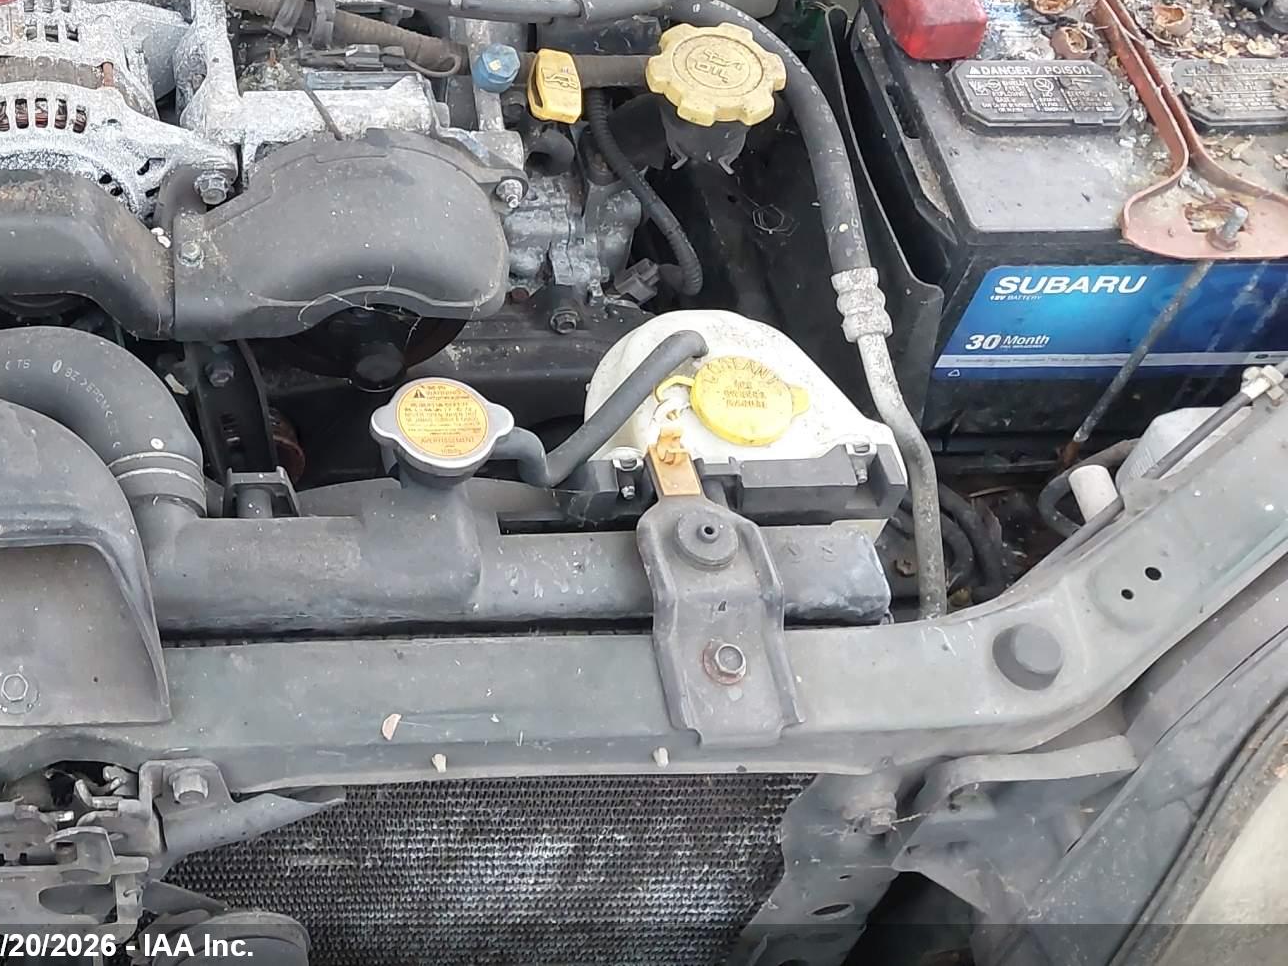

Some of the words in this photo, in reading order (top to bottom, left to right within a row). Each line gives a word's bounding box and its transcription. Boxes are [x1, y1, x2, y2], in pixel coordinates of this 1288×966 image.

[980, 65, 1033, 76] DANGER
[1043, 65, 1092, 76] POISON
[993, 275, 1148, 295] SUBARU
[964, 333, 1002, 351] 30
[1003, 334, 1051, 346] Month
